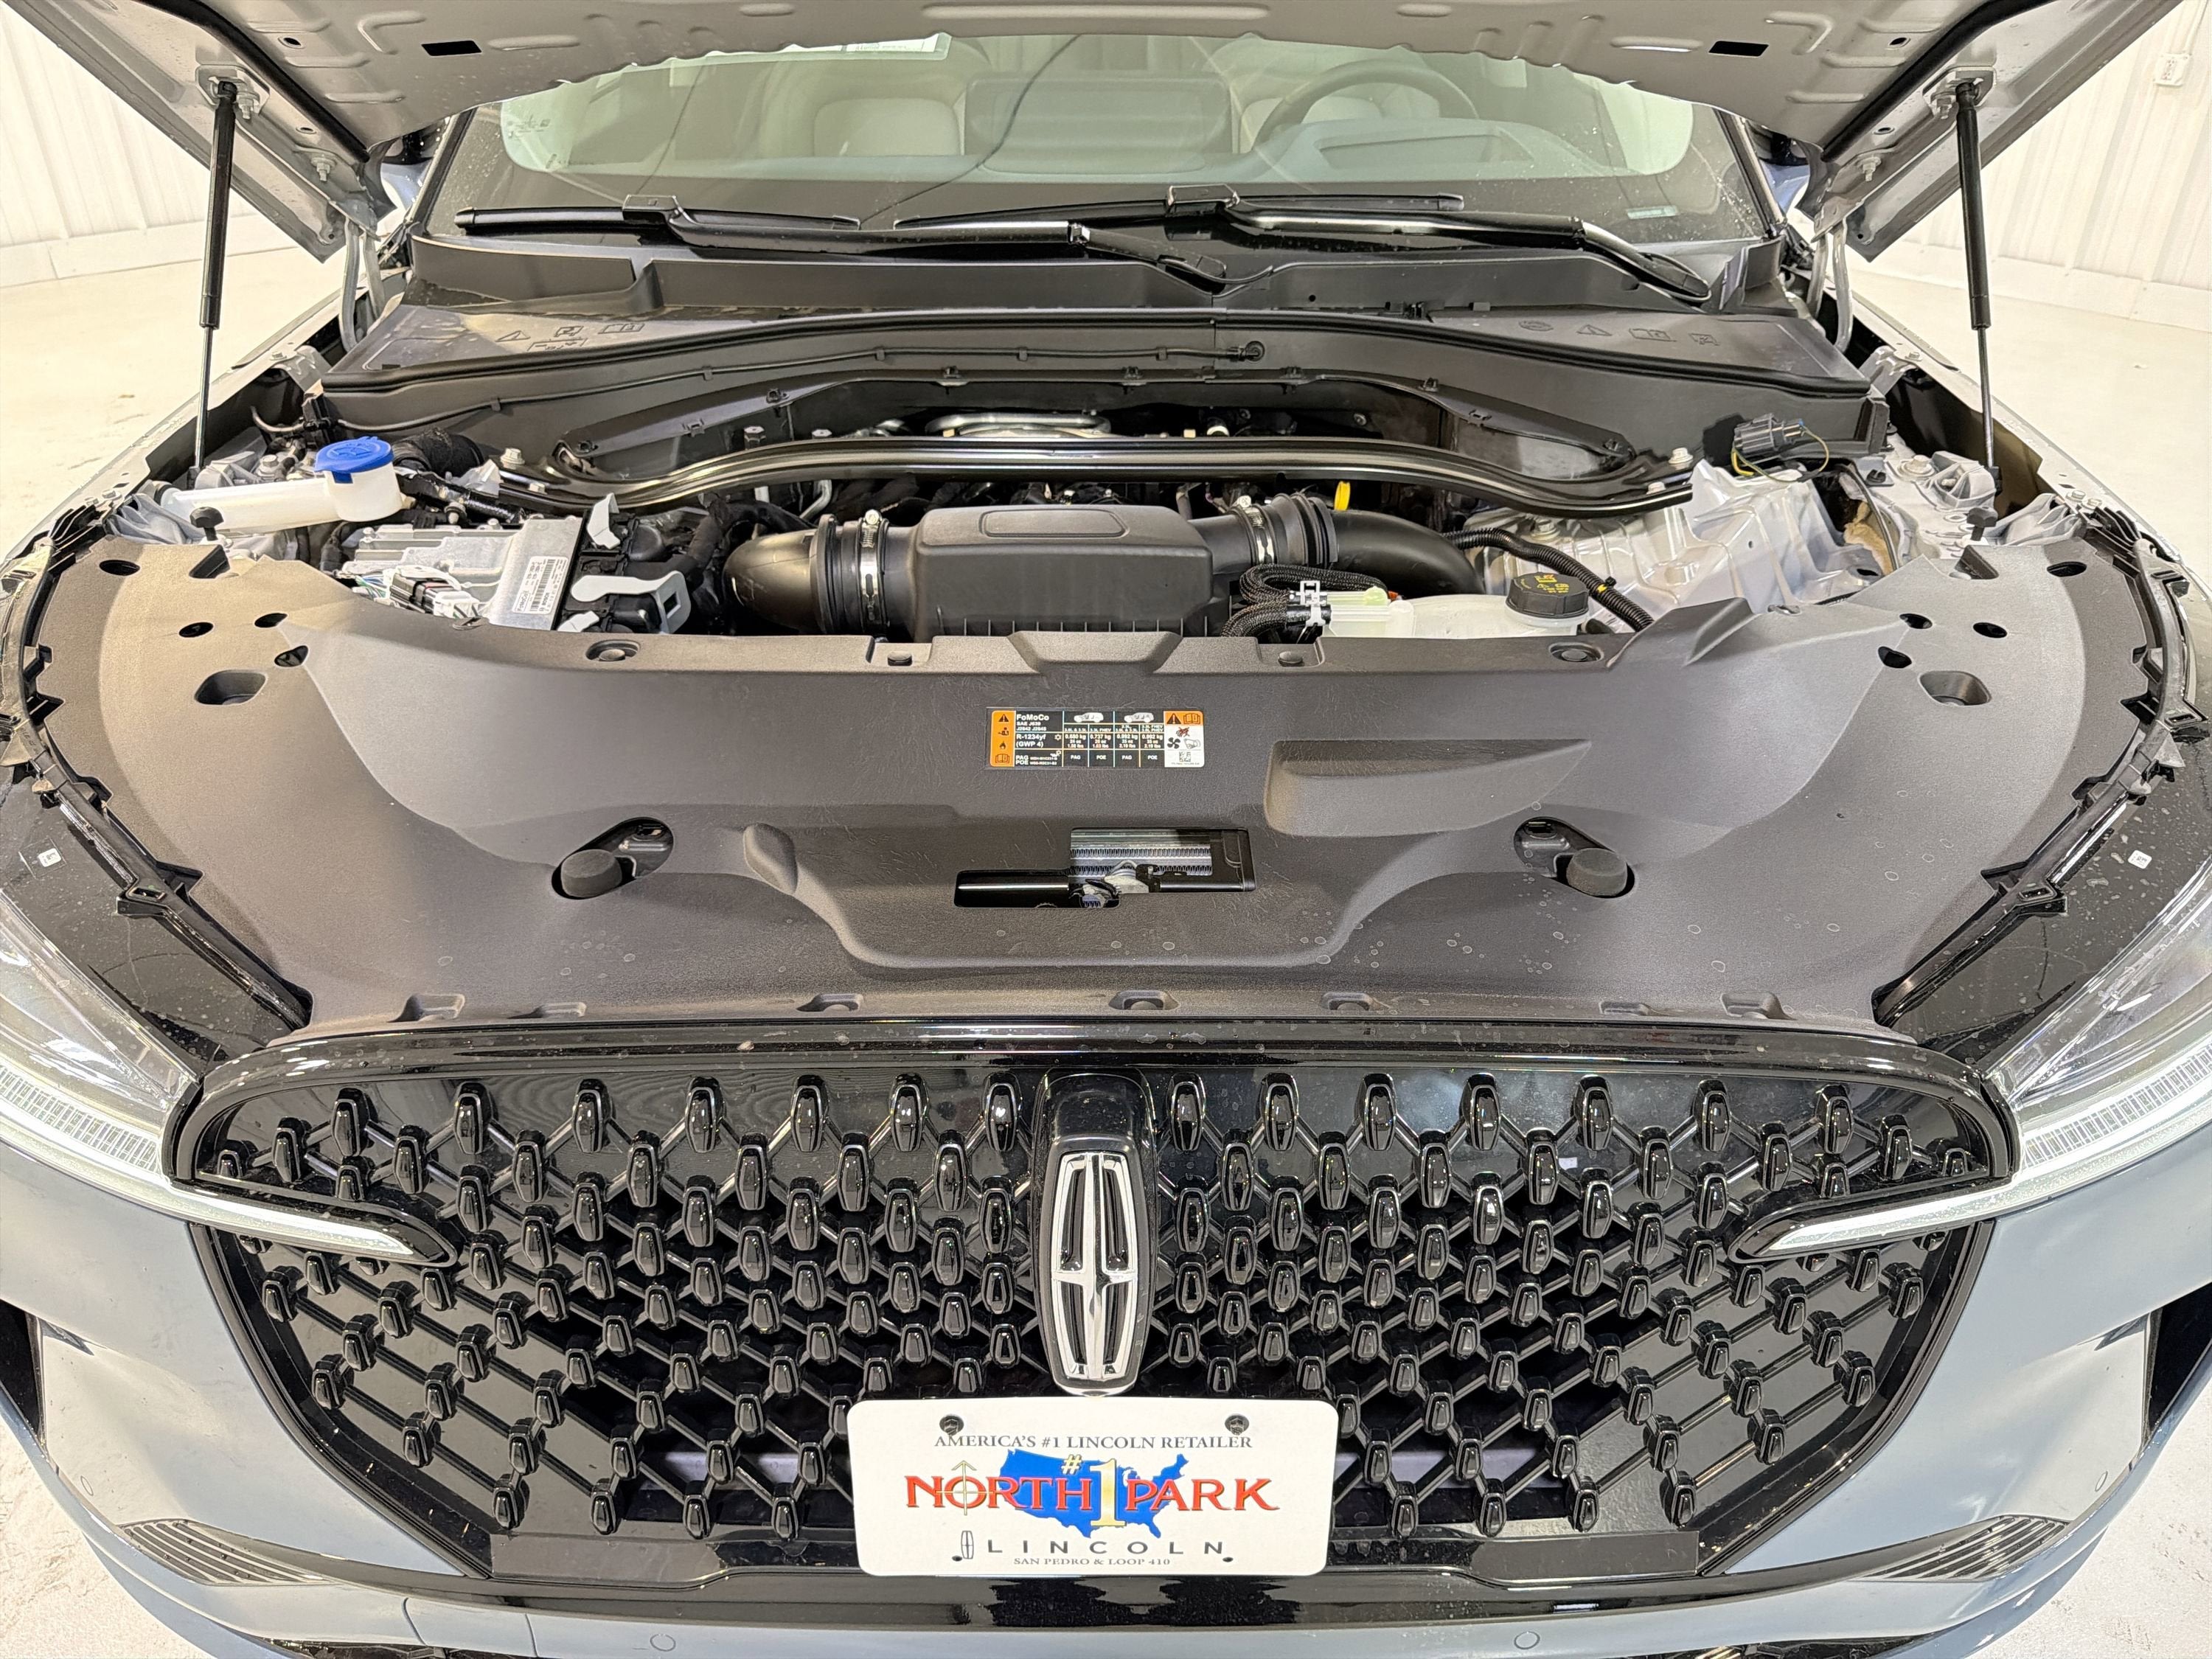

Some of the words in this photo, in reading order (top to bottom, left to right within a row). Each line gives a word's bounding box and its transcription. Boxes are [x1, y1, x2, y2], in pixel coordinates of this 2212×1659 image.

[934, 1434, 1036, 1447] AMERICA'S
[1041, 1436, 1061, 1448] #1
[1066, 1436, 1155, 1449] LINCOLN
[1160, 1436, 1253, 1449] RETAILER
[904, 1475, 1092, 1511] NORTH
[1125, 1478, 1281, 1512] PARK
[987, 1539, 1223, 1555] LINCOLN
[1014, 1557, 1040, 1565] SAN
[1043, 1557, 1090, 1565] PEDRO
[1093, 1557, 1105, 1565] &
[1108, 1557, 1145, 1565] LOOP
